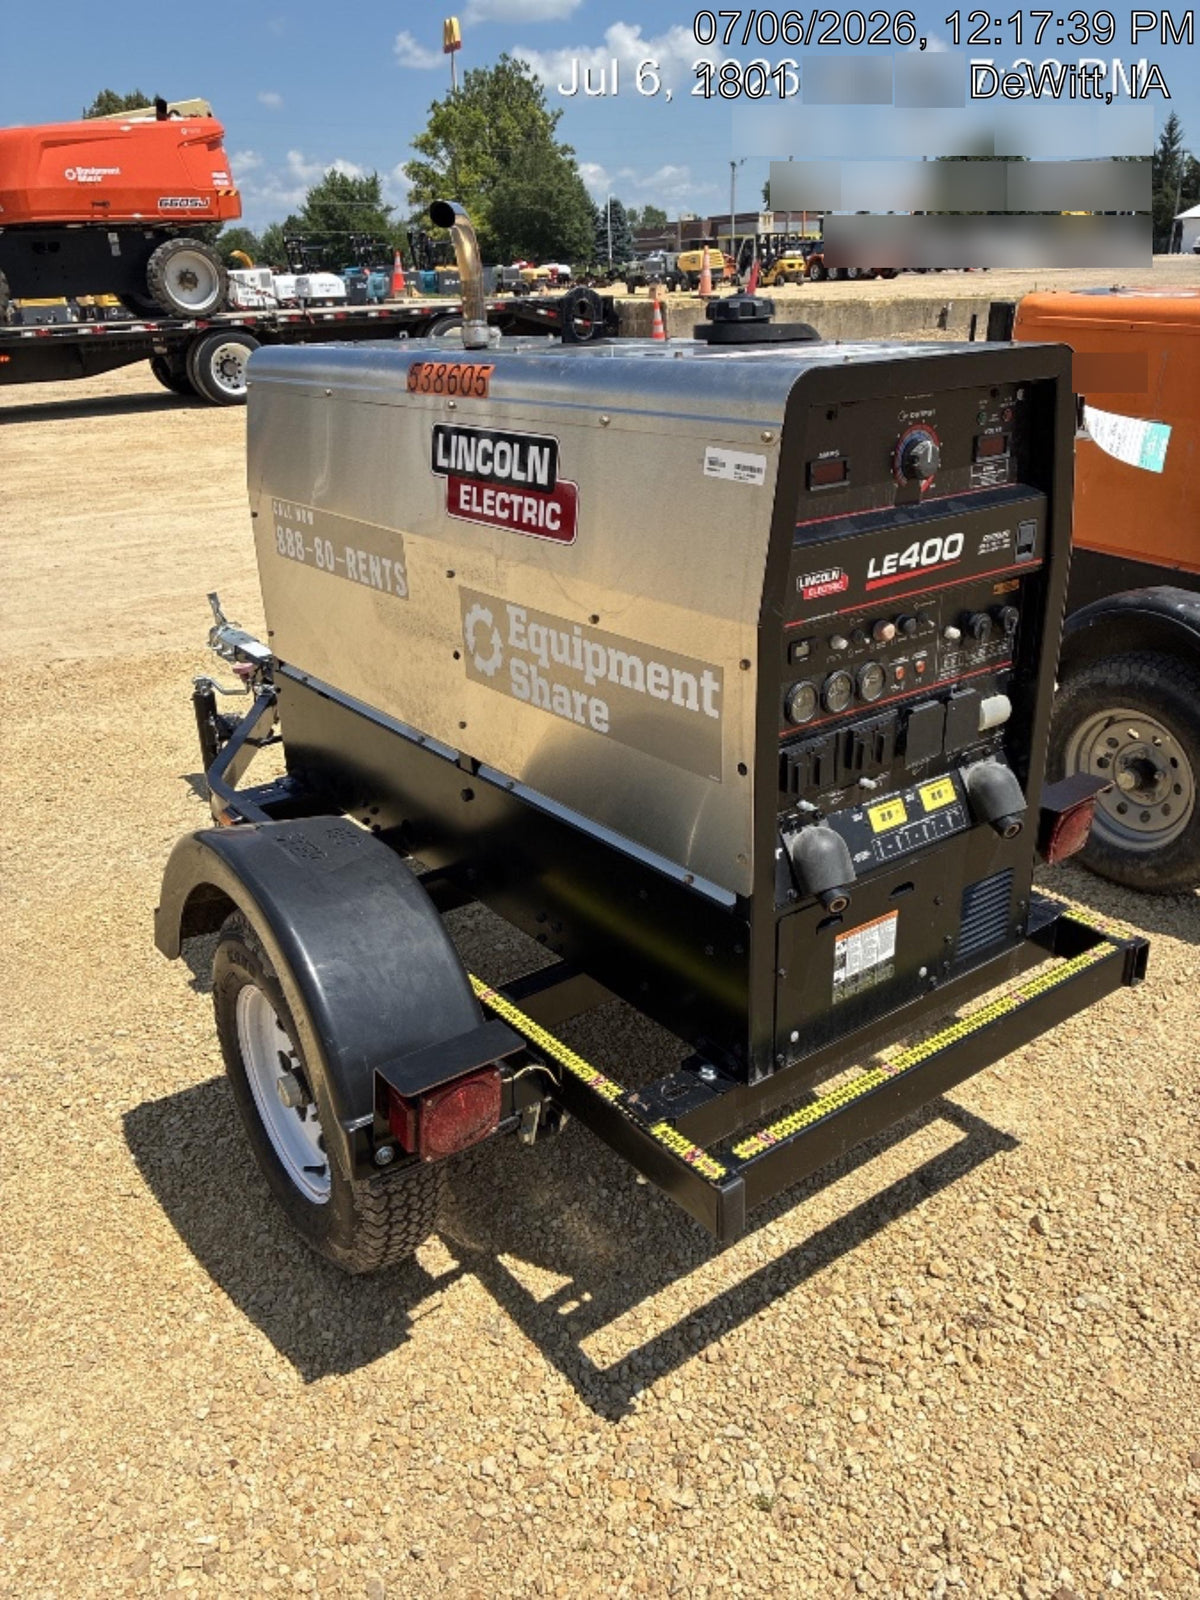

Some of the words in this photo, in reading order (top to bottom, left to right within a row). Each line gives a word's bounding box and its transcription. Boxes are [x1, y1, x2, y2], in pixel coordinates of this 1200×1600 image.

[407, 362, 491, 397] 538605
[436, 432, 550, 487] LINCOLN
[459, 484, 562, 531] ELECTRIC
[276, 525, 408, 597] 888-80-RENTS
[799, 569, 841, 588] LINCOLN
[867, 532, 965, 579] LE400
[808, 580, 844, 597] ELECTRIC
[506, 603, 721, 720] Equipment
[509, 656, 610, 734] Share
[772, 1120, 792, 1136] DO
[792, 1106, 818, 1125] NOT
